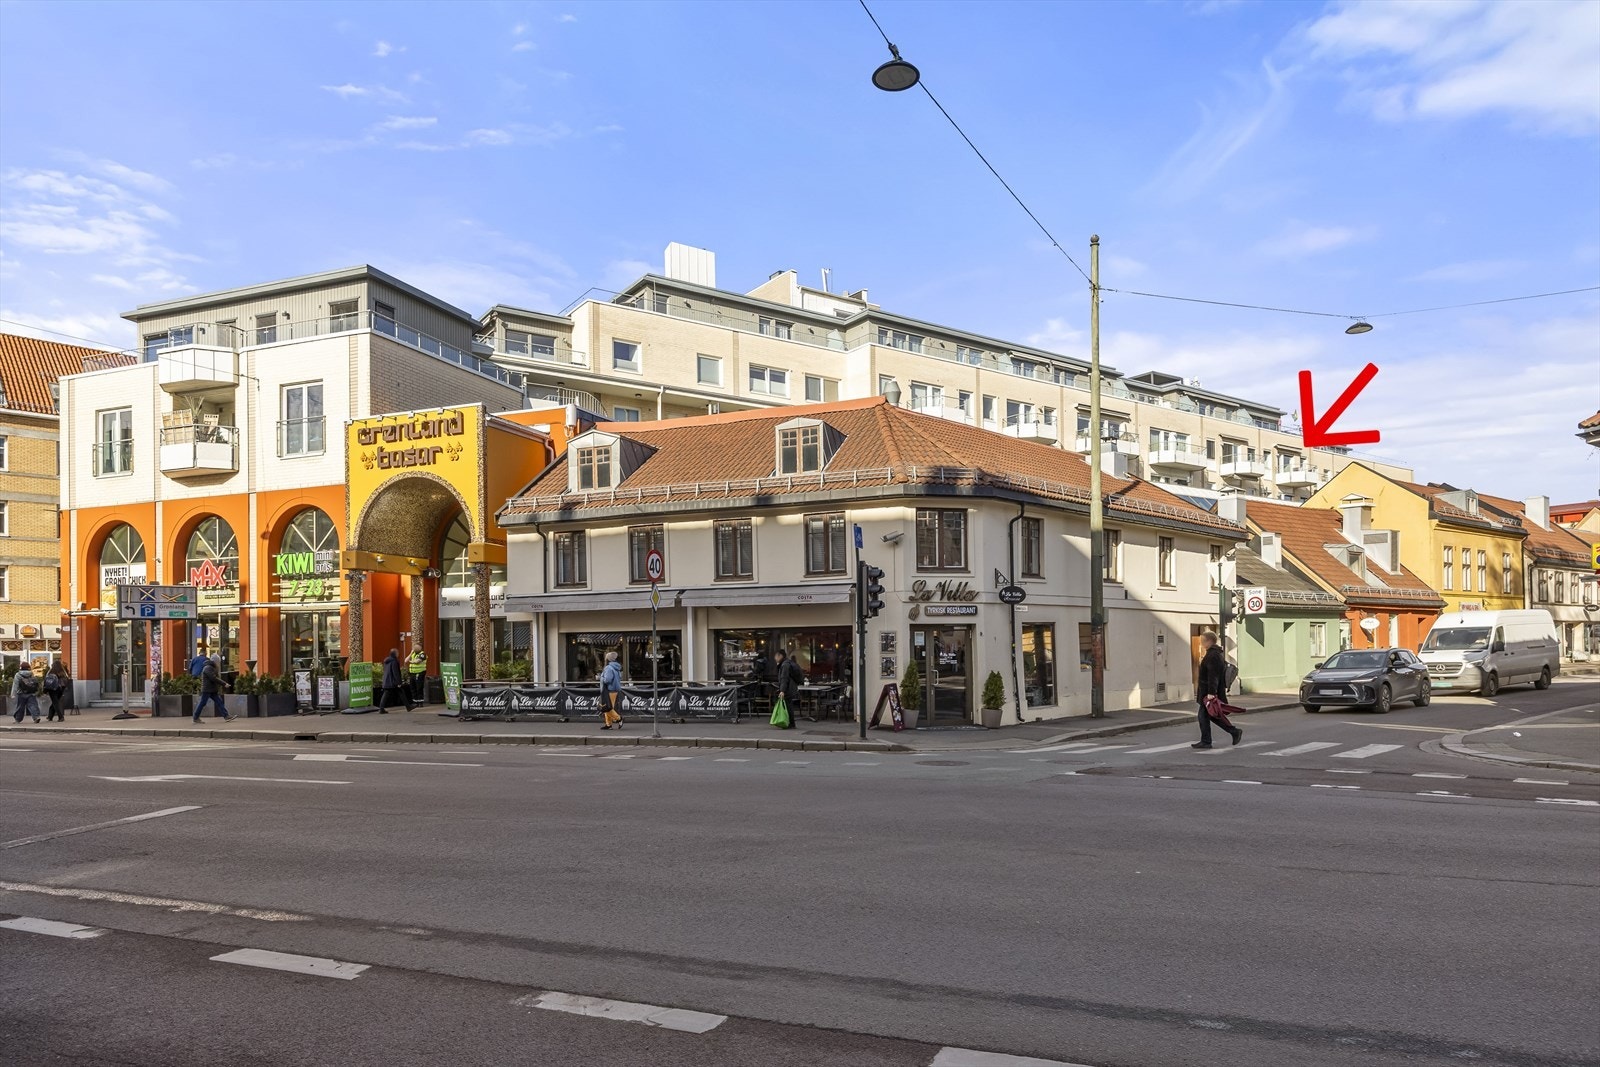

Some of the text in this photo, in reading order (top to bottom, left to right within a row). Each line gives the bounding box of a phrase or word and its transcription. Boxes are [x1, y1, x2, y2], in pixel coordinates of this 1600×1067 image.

[315, 549, 333, 561] mini
[276, 552, 314, 575] KIWI
[315, 563, 331, 574] pris
[649, 558, 661, 574] 40
[105, 567, 128, 577] NYHET!
[190, 558, 226, 587] MAX
[104, 576, 127, 586] GRAND
[908, 579, 980, 602] La Villa
[1250, 600, 1261, 608] 30
[927, 606, 977, 614] TYRKISK RESTAURANT
[469, 695, 507, 707] La Villa
[519, 696, 558, 707] La Villa
[574, 696, 589, 707] La
[630, 696, 672, 707] La Vlla
[688, 695, 733, 707] La Villa
